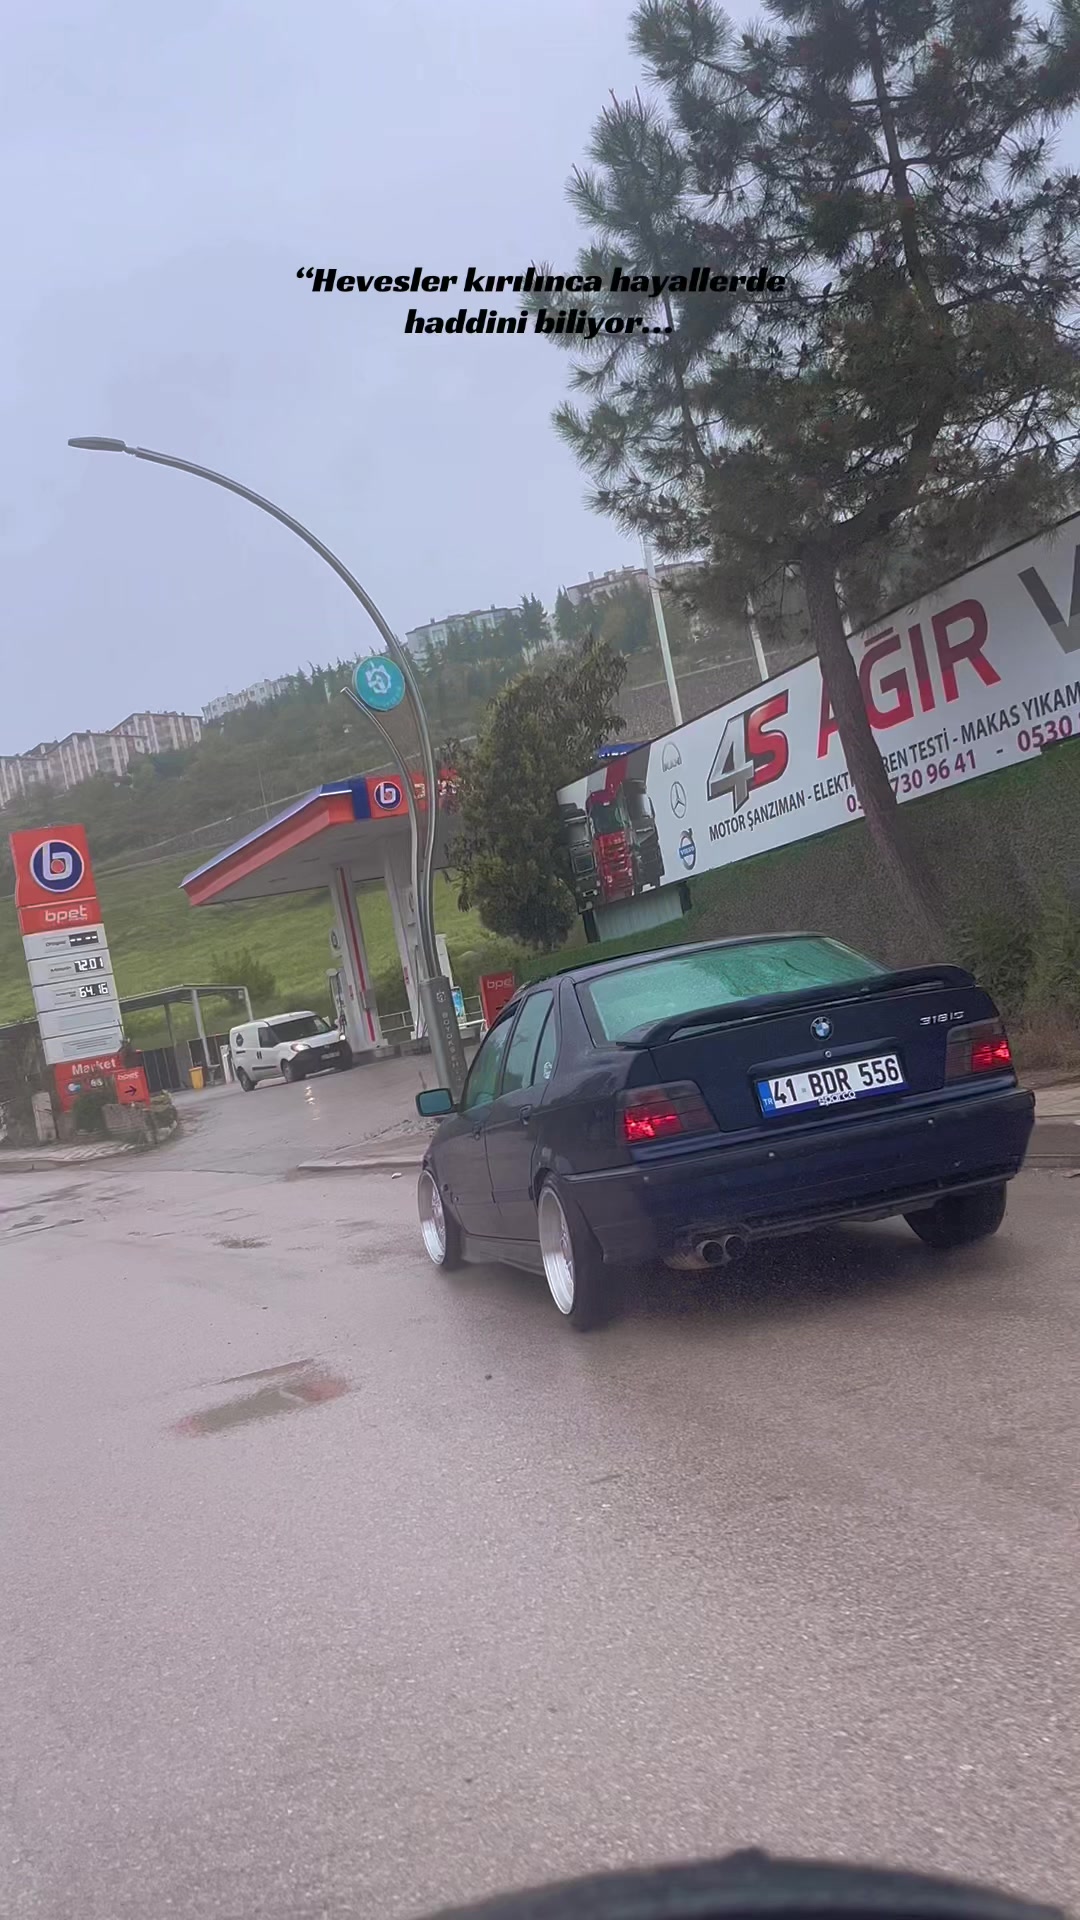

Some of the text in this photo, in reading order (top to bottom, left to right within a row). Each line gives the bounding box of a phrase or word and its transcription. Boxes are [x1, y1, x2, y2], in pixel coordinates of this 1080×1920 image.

[706, 689, 789, 813] 4S
[890, 768, 923, 794] 730
[926, 758, 951, 784] 96
[953, 749, 976, 773] 41
[1016, 715, 1073, 752] 0530
[708, 814, 746, 842] MOTOR
[747, 789, 806, 831] ŞANZIMAN
[812, 771, 855, 802] ELEKT
[881, 751, 908, 773] REN
[909, 727, 949, 764] TESTİ
[960, 704, 1020, 745] MAKAS
[45, 904, 88, 924] bpet
[78, 983, 109, 998] 64.16
[71, 1058, 117, 1076] Market
[773, 1057, 899, 1104] 41 BDR 556
[762, 1098, 773, 1106] TR
